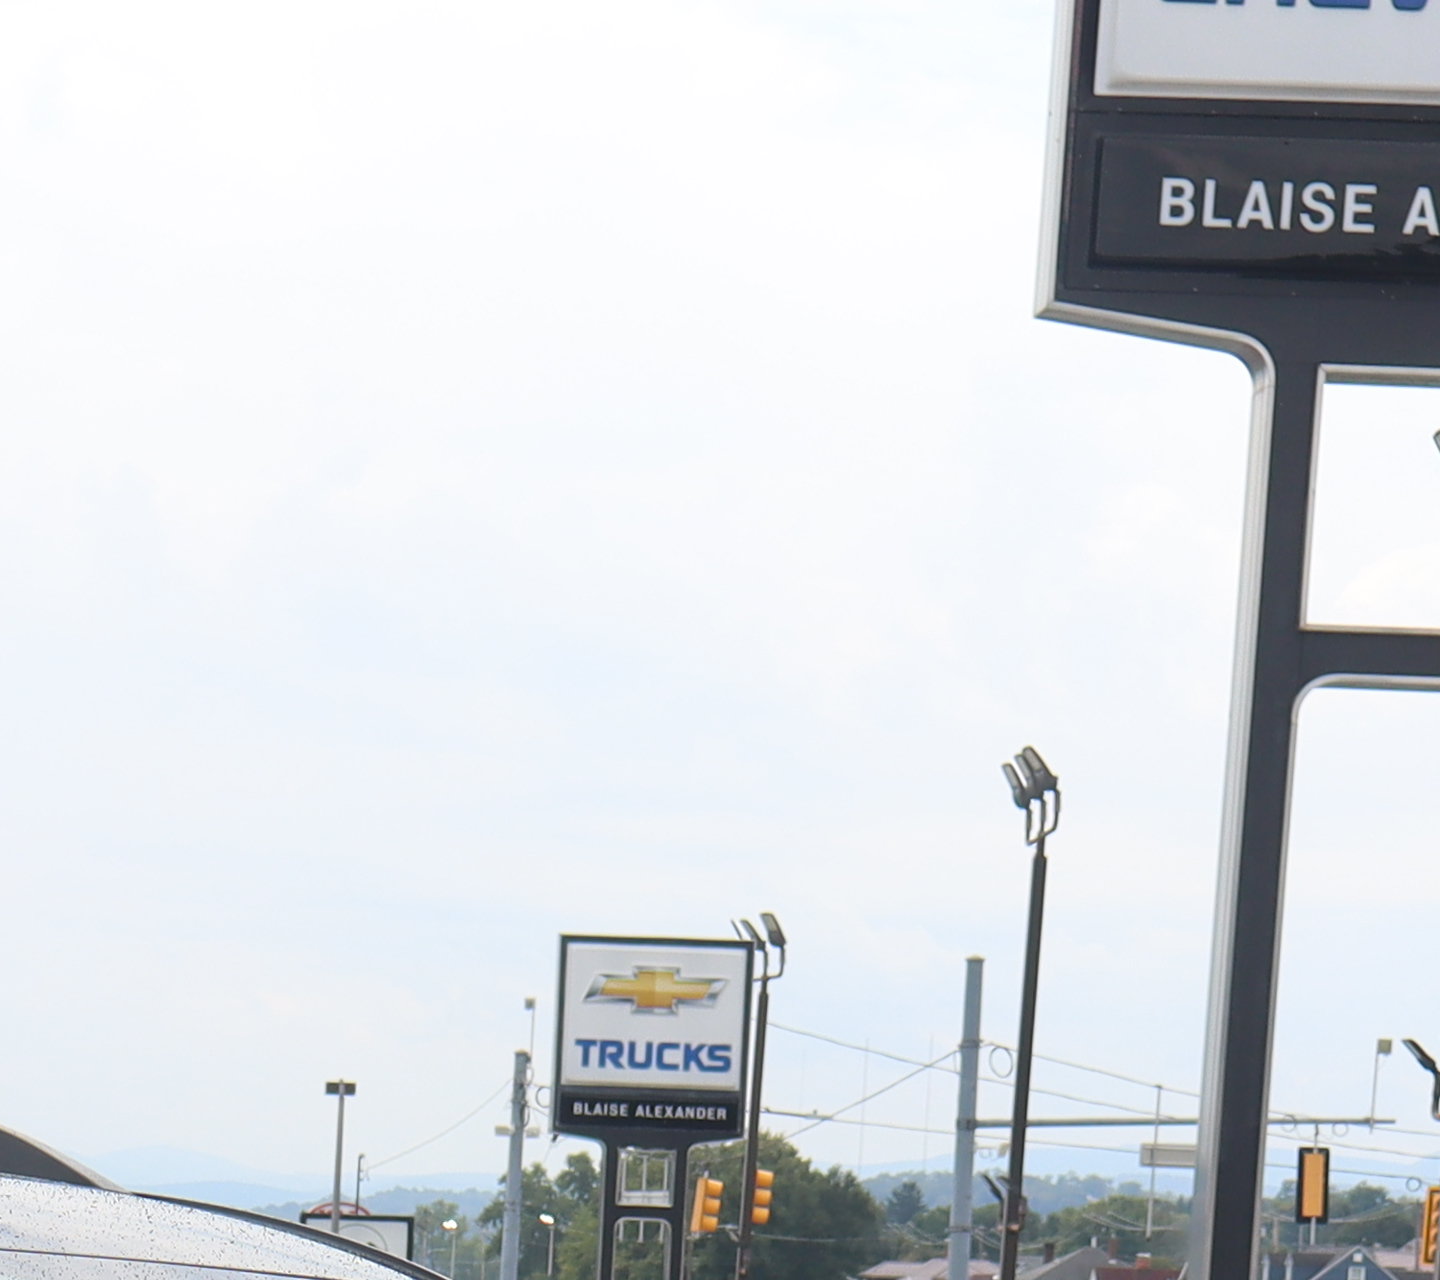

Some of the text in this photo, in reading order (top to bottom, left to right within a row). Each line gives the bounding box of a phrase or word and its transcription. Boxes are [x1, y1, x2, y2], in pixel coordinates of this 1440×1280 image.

[1158, 176, 1378, 235] BLAISE
[574, 1039, 733, 1074] TRUCKS
[572, 1102, 729, 1121] BLAISE ALEXANDER
